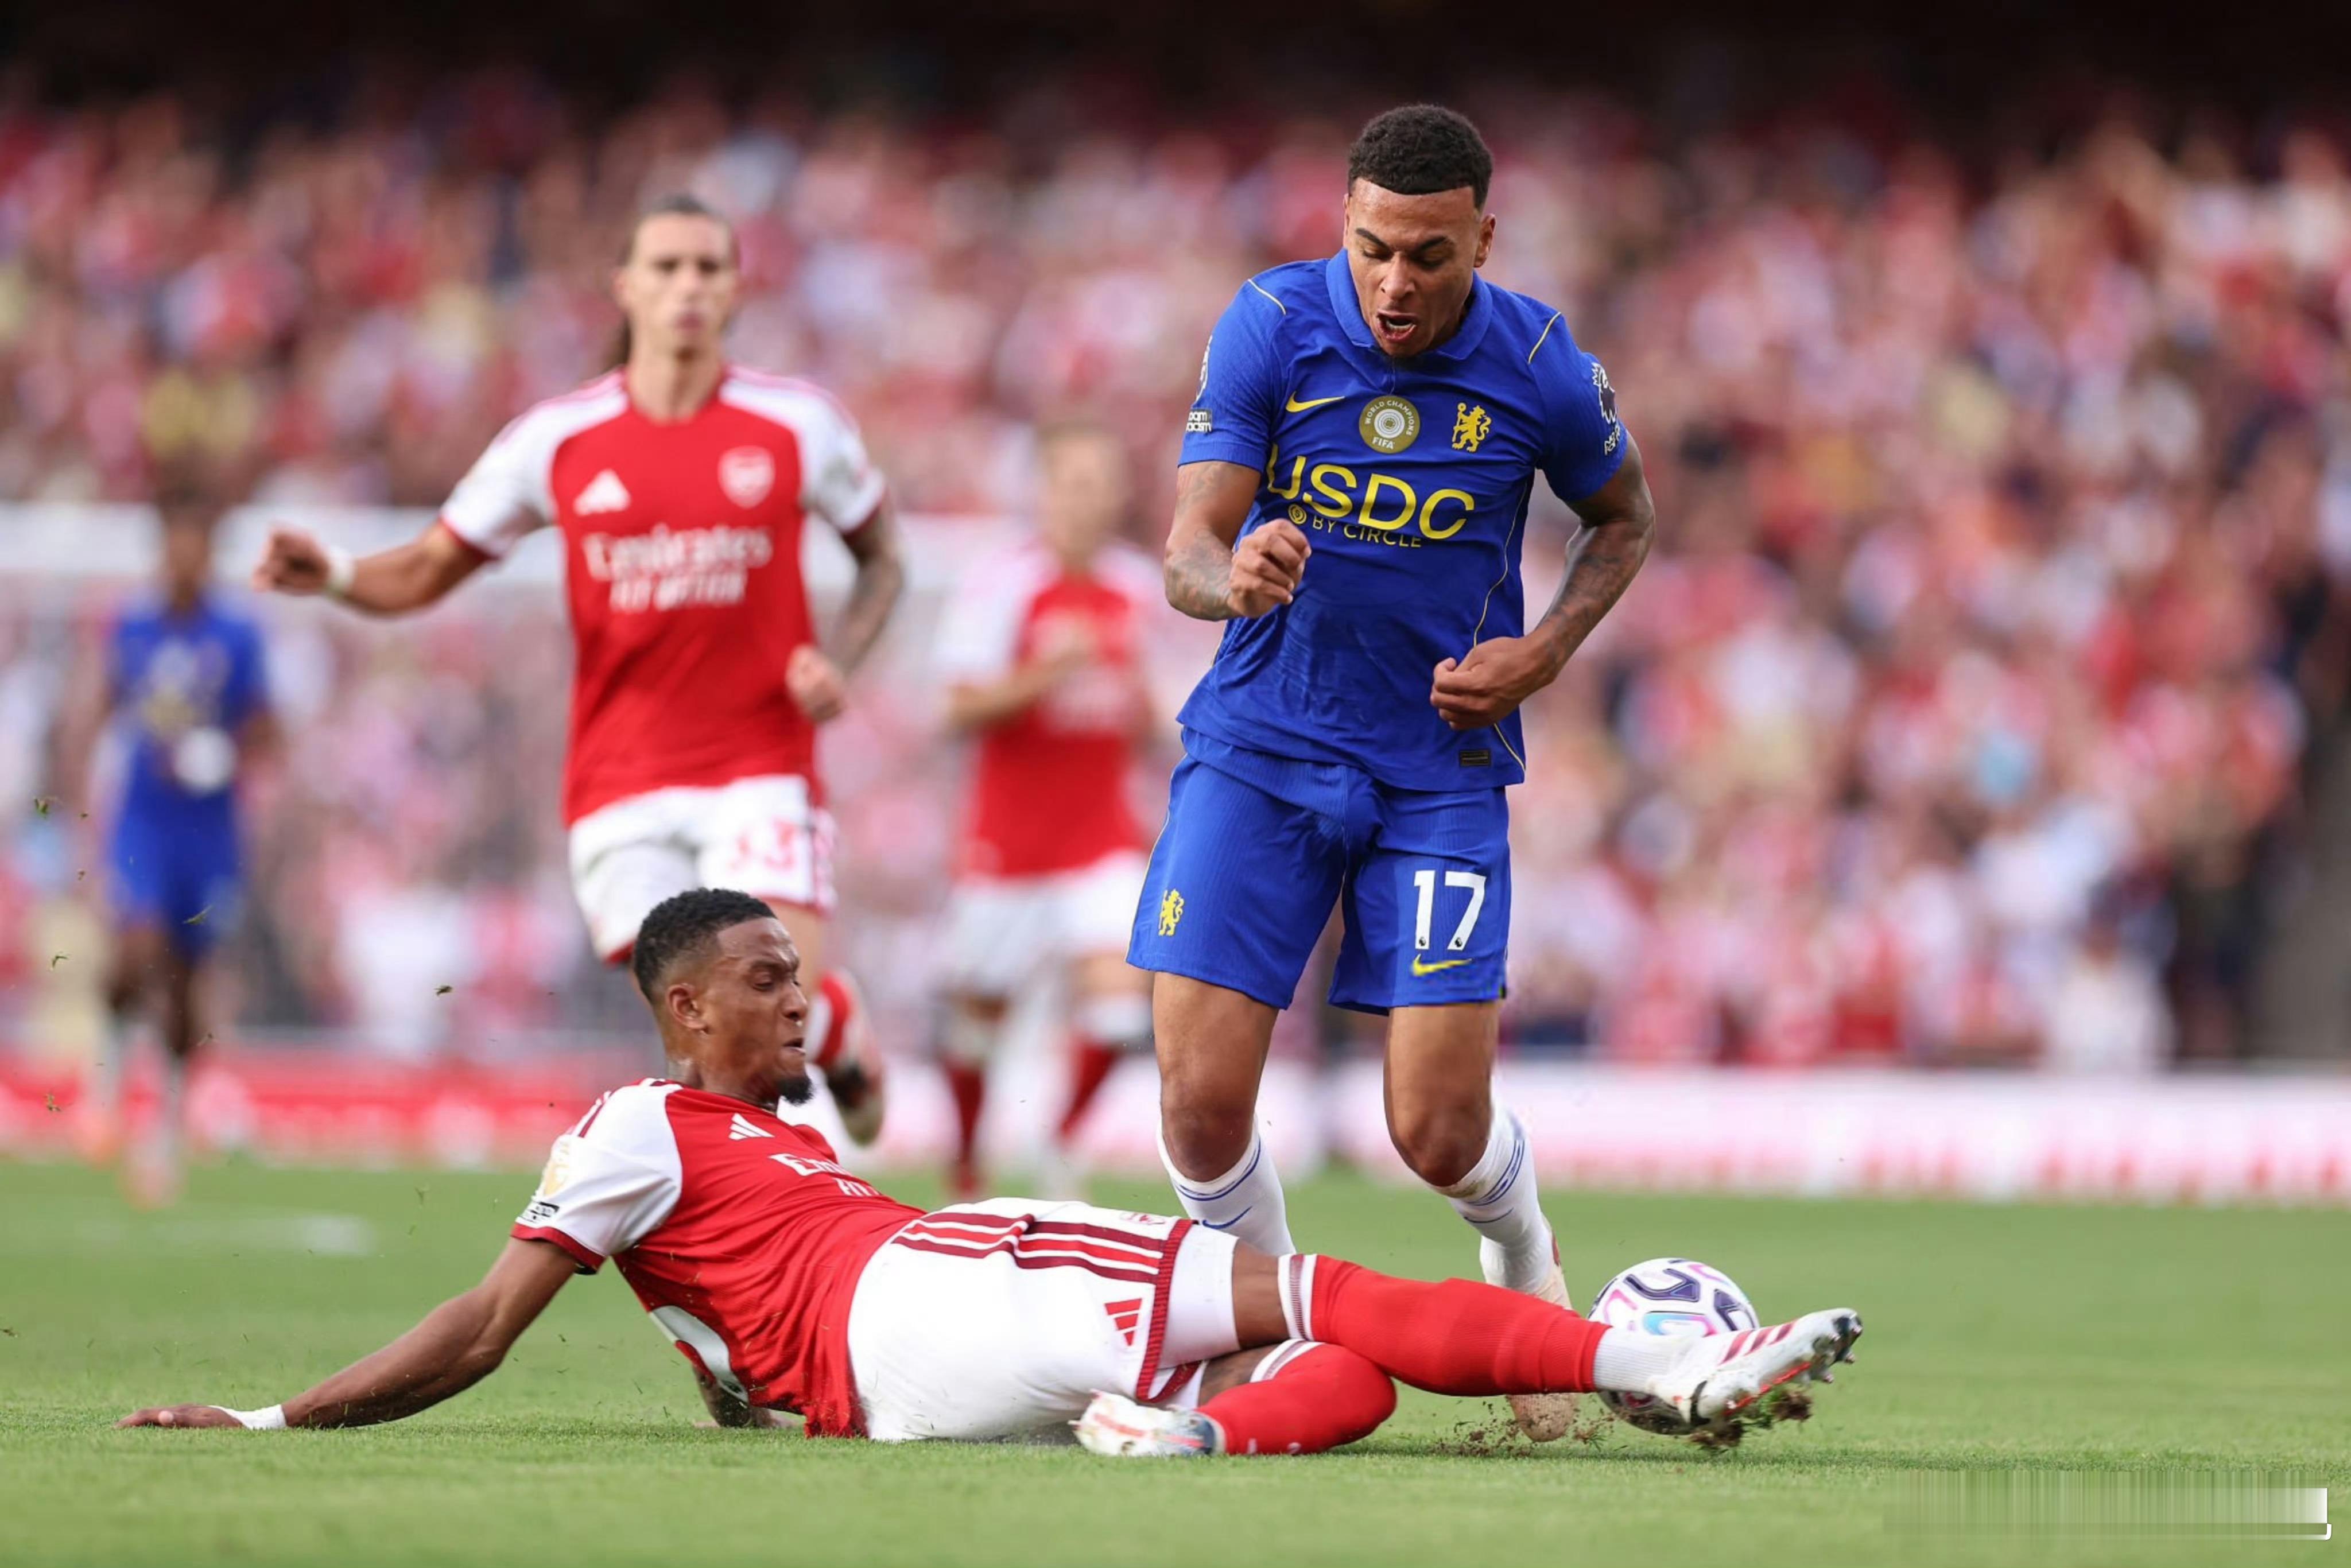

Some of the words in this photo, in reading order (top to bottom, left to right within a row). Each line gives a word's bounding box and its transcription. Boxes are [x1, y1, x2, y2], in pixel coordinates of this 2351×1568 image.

[1365, 401, 1384, 424] WORLD
[1386, 400, 1415, 436] CHAMPIONS
[1372, 437, 1394, 449] FIFA
[1266, 443, 1475, 540] USDC
[1313, 515, 1336, 533] BY
[1344, 523, 1422, 548] CIRCLE
[1414, 870, 1487, 951] 17
